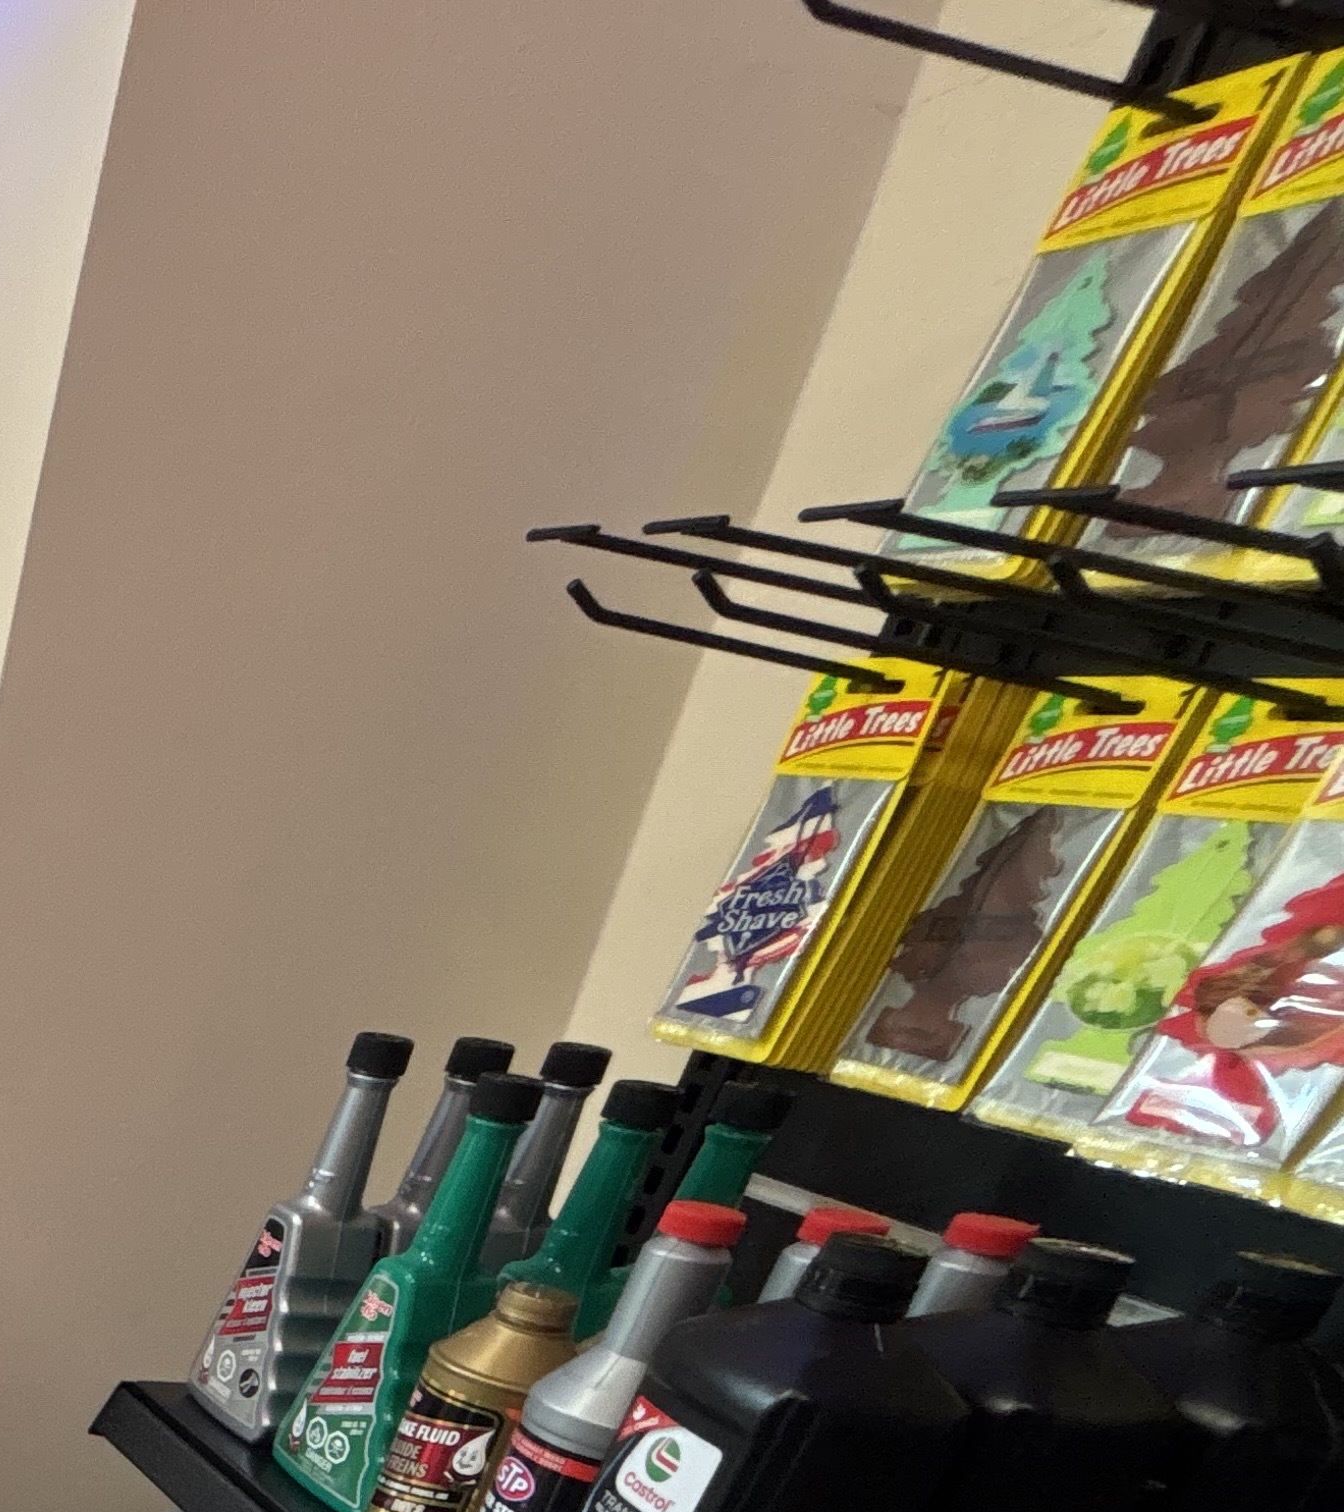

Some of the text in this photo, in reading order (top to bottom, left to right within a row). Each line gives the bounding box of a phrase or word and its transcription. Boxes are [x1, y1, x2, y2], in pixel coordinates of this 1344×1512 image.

[1051, 126, 1249, 230] Little Trees
[784, 706, 928, 758] Little Trees
[998, 727, 1168, 784] Little Trees
[1176, 742, 1280, 793] Little
[728, 881, 804, 909] Fresh
[717, 908, 799, 932] Shave
[417, 1425, 461, 1446] FLUID
[497, 1462, 529, 1492] STP
